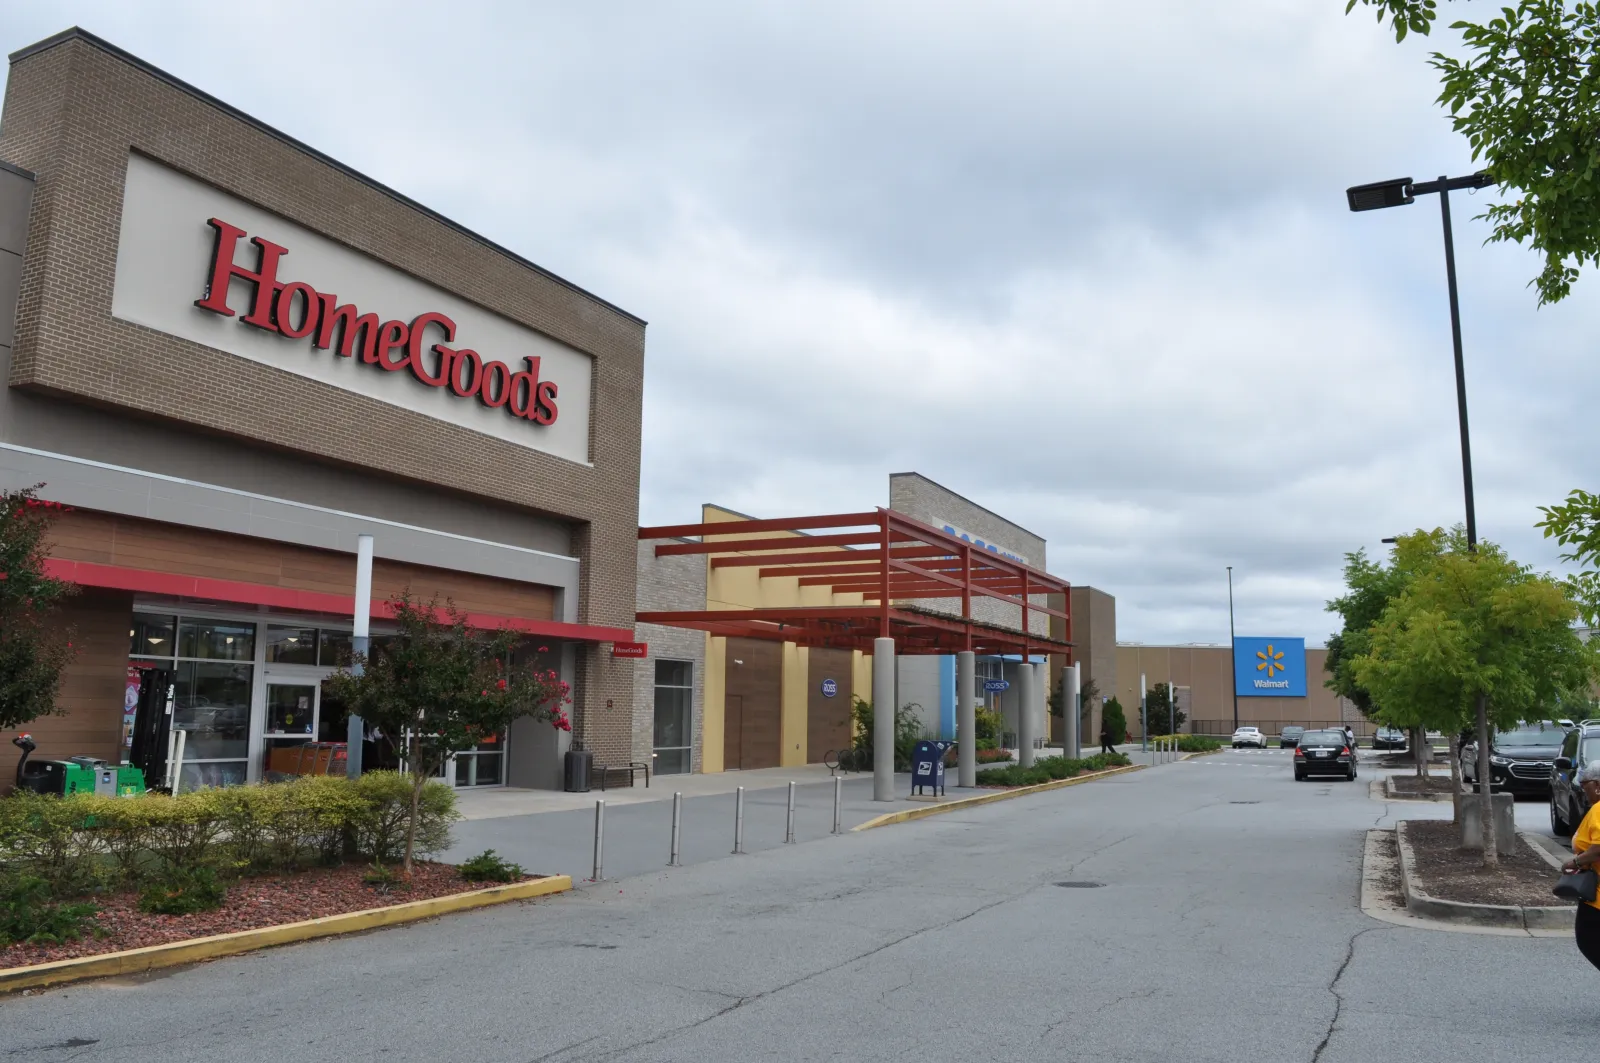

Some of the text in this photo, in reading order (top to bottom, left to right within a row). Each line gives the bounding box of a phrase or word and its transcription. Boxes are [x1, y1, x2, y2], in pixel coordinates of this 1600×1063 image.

[194, 217, 558, 426] HomeGoods
[1253, 679, 1289, 688] Walmart
[824, 684, 836, 693] ROSS
